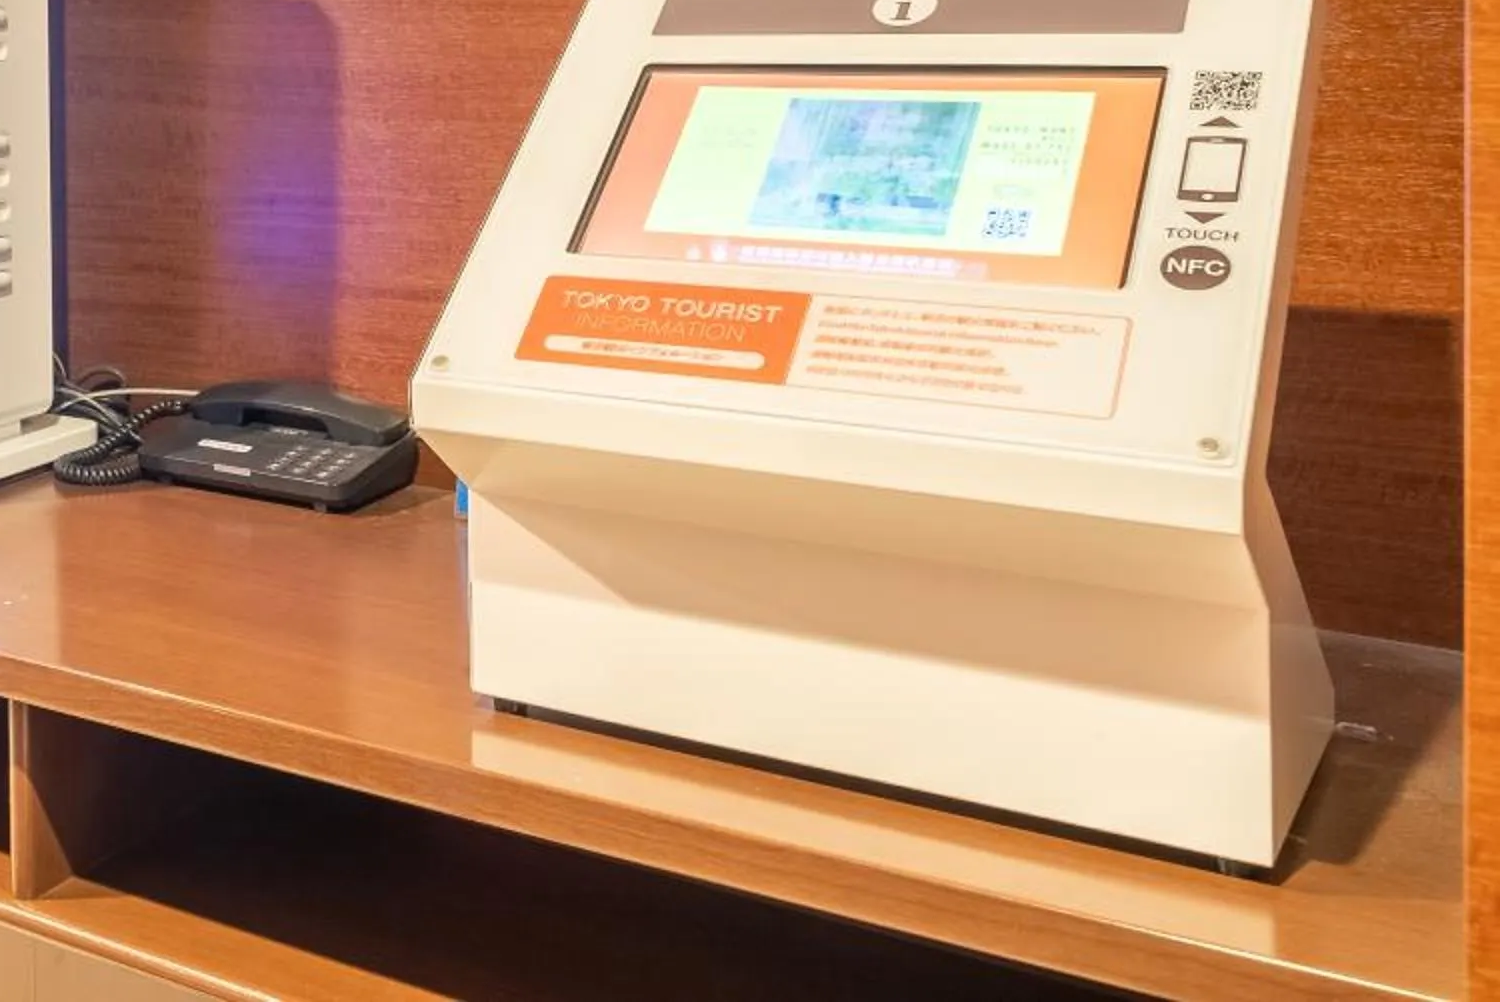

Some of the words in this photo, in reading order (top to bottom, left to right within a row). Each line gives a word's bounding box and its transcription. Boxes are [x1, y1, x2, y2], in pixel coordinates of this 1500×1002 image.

[1164, 228, 1239, 242] TOUCH
[1167, 257, 1225, 277] NFC
[563, 290, 651, 313] TOKYO
[660, 297, 782, 323] TOURIST
[574, 312, 747, 343] INFORMATION
